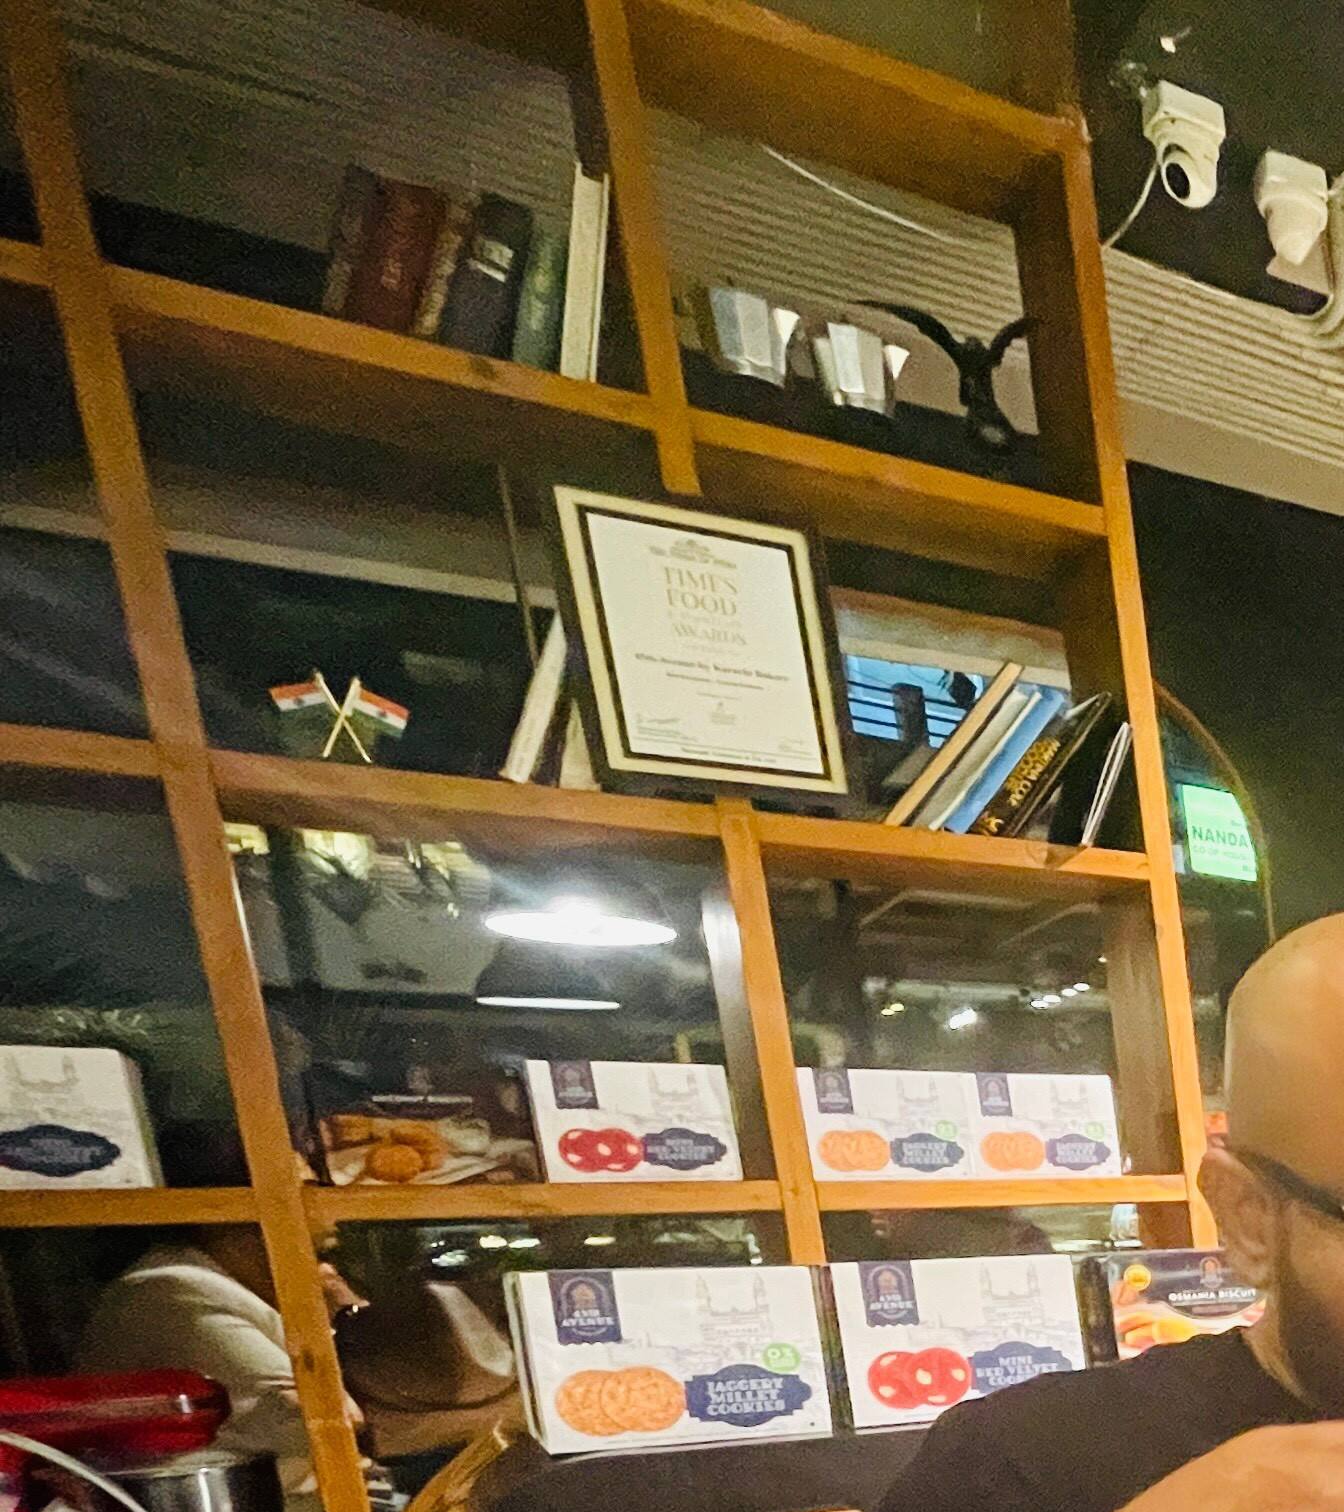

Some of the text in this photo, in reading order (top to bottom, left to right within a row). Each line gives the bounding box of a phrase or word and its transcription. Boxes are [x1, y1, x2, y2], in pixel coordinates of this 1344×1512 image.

[666, 588, 737, 616] FOOD
[1192, 825, 1249, 848] NANDA
[999, 1355, 1032, 1366] MINI
[976, 1367, 1005, 1378] RED
[706, 1377, 784, 1393] JAGGERY
[709, 1389, 780, 1404] MILLET
[706, 1400, 786, 1416] COOKIES
